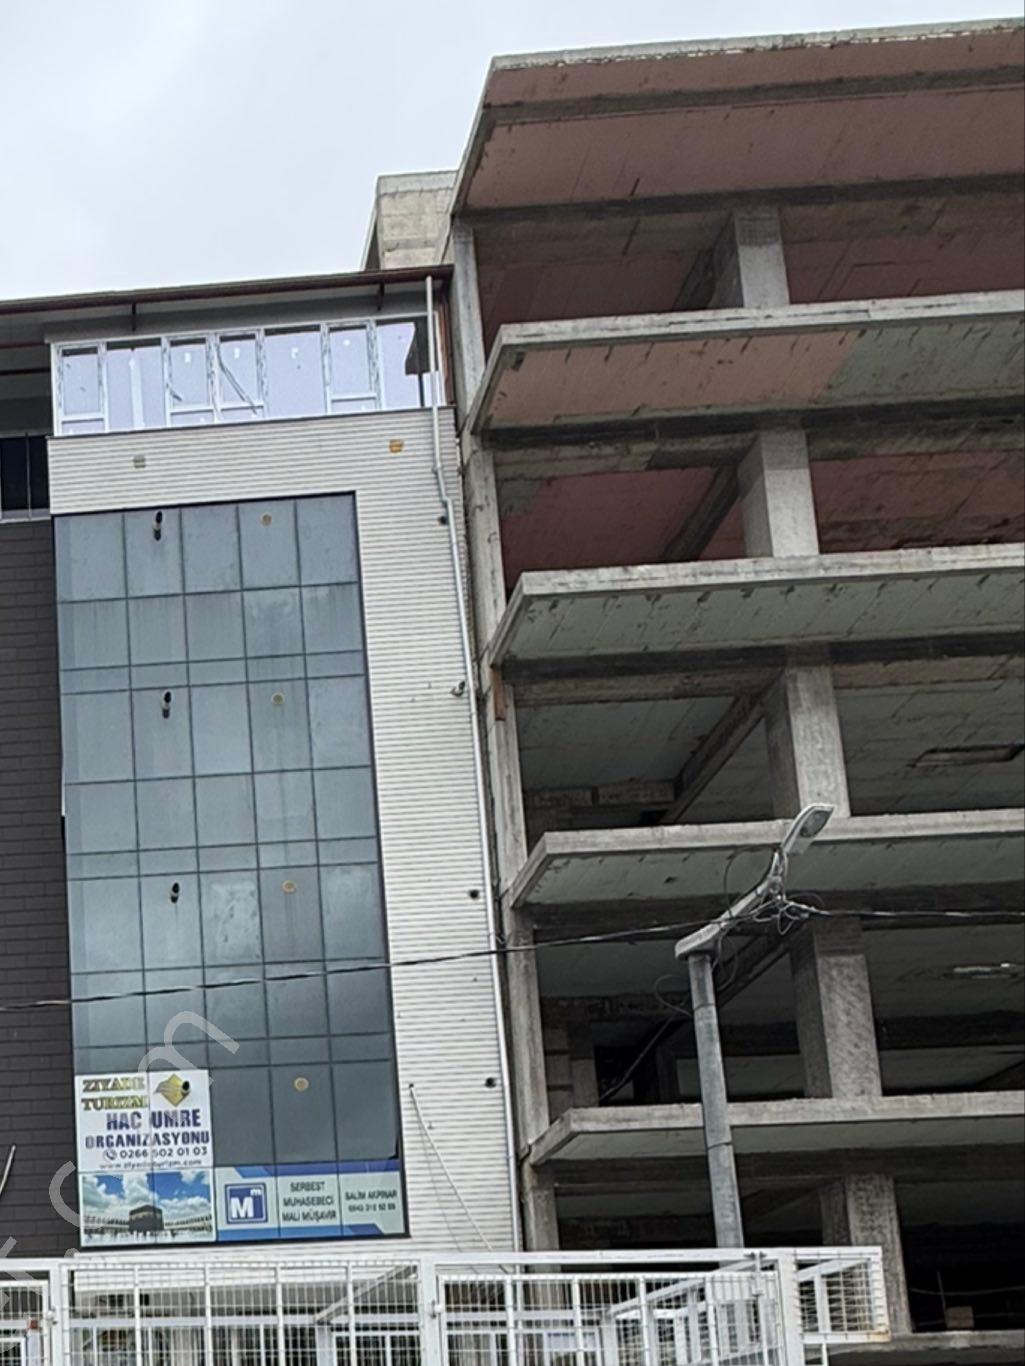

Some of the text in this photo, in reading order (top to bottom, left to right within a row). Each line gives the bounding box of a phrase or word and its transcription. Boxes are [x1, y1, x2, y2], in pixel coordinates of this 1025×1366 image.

[106, 1111, 143, 1131] HAC
[119, 1149, 149, 1159] 0266
[177, 1147, 190, 1156] 01
[193, 1146, 208, 1155] 03
